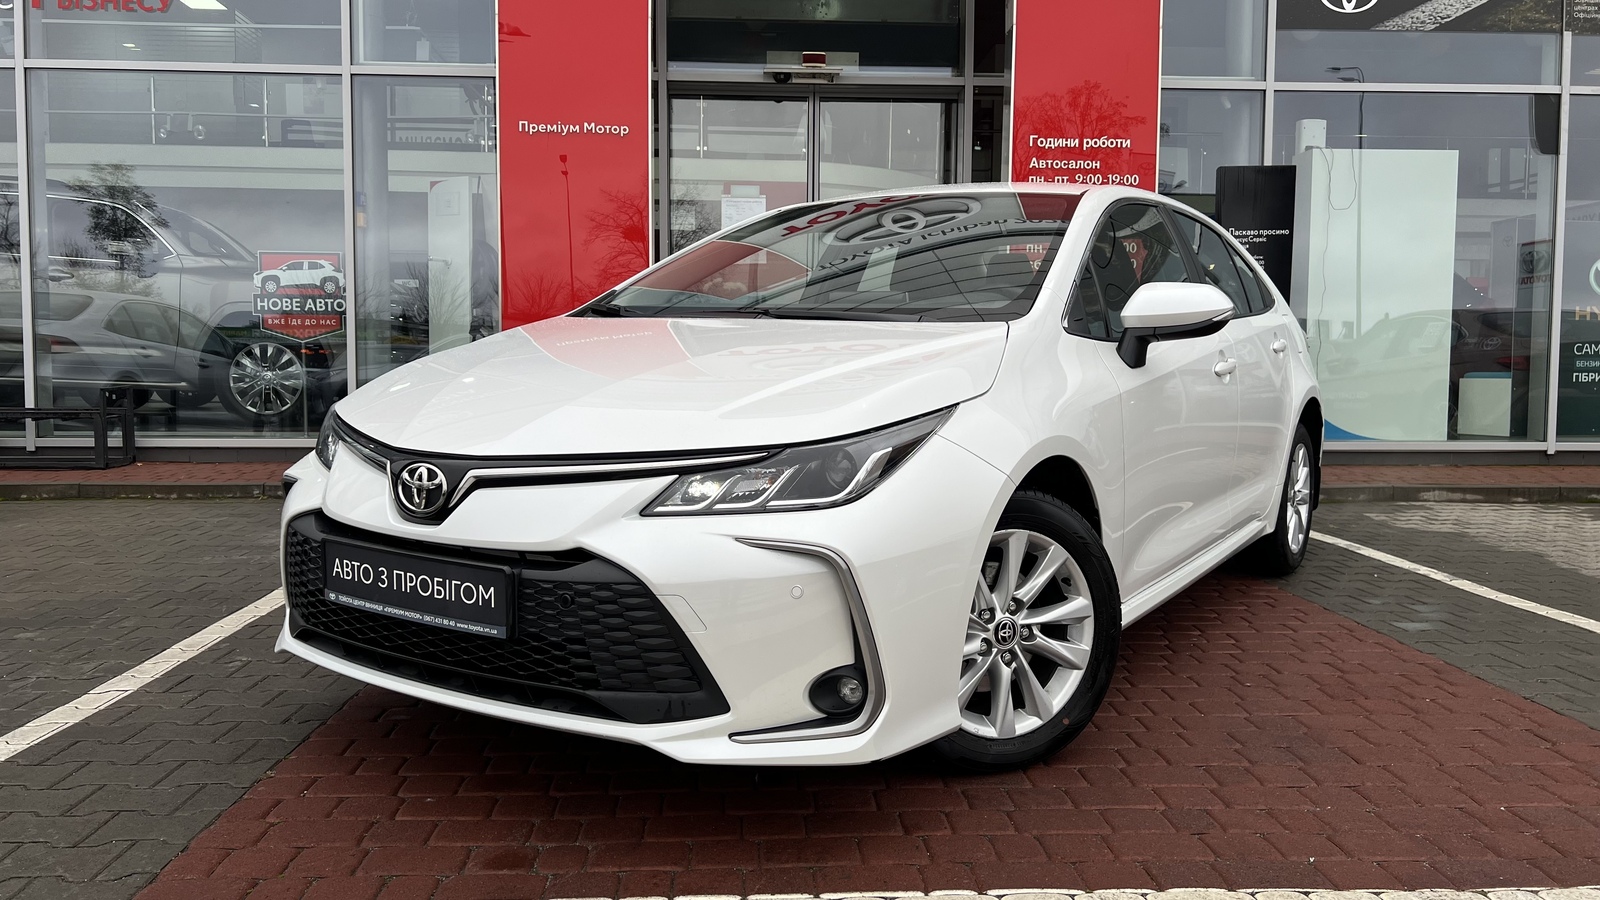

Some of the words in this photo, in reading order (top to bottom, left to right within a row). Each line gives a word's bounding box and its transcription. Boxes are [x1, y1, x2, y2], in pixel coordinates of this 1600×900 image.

[518, 121, 580, 135] Преміум
[583, 122, 629, 137] Мотор
[1029, 135, 1079, 149] Години
[1083, 136, 1131, 150] роботи
[1029, 157, 1100, 169] Автосалон
[1075, 173, 1139, 185] 9:00-19:00
[257, 298, 300, 311] НОВЕ
[304, 299, 346, 312] АВТО
[288, 318, 302, 326] ЇДЕ
[333, 558, 373, 584] АВТО
[378, 567, 388, 588] З
[393, 570, 494, 608] ПРОБІГОМ
